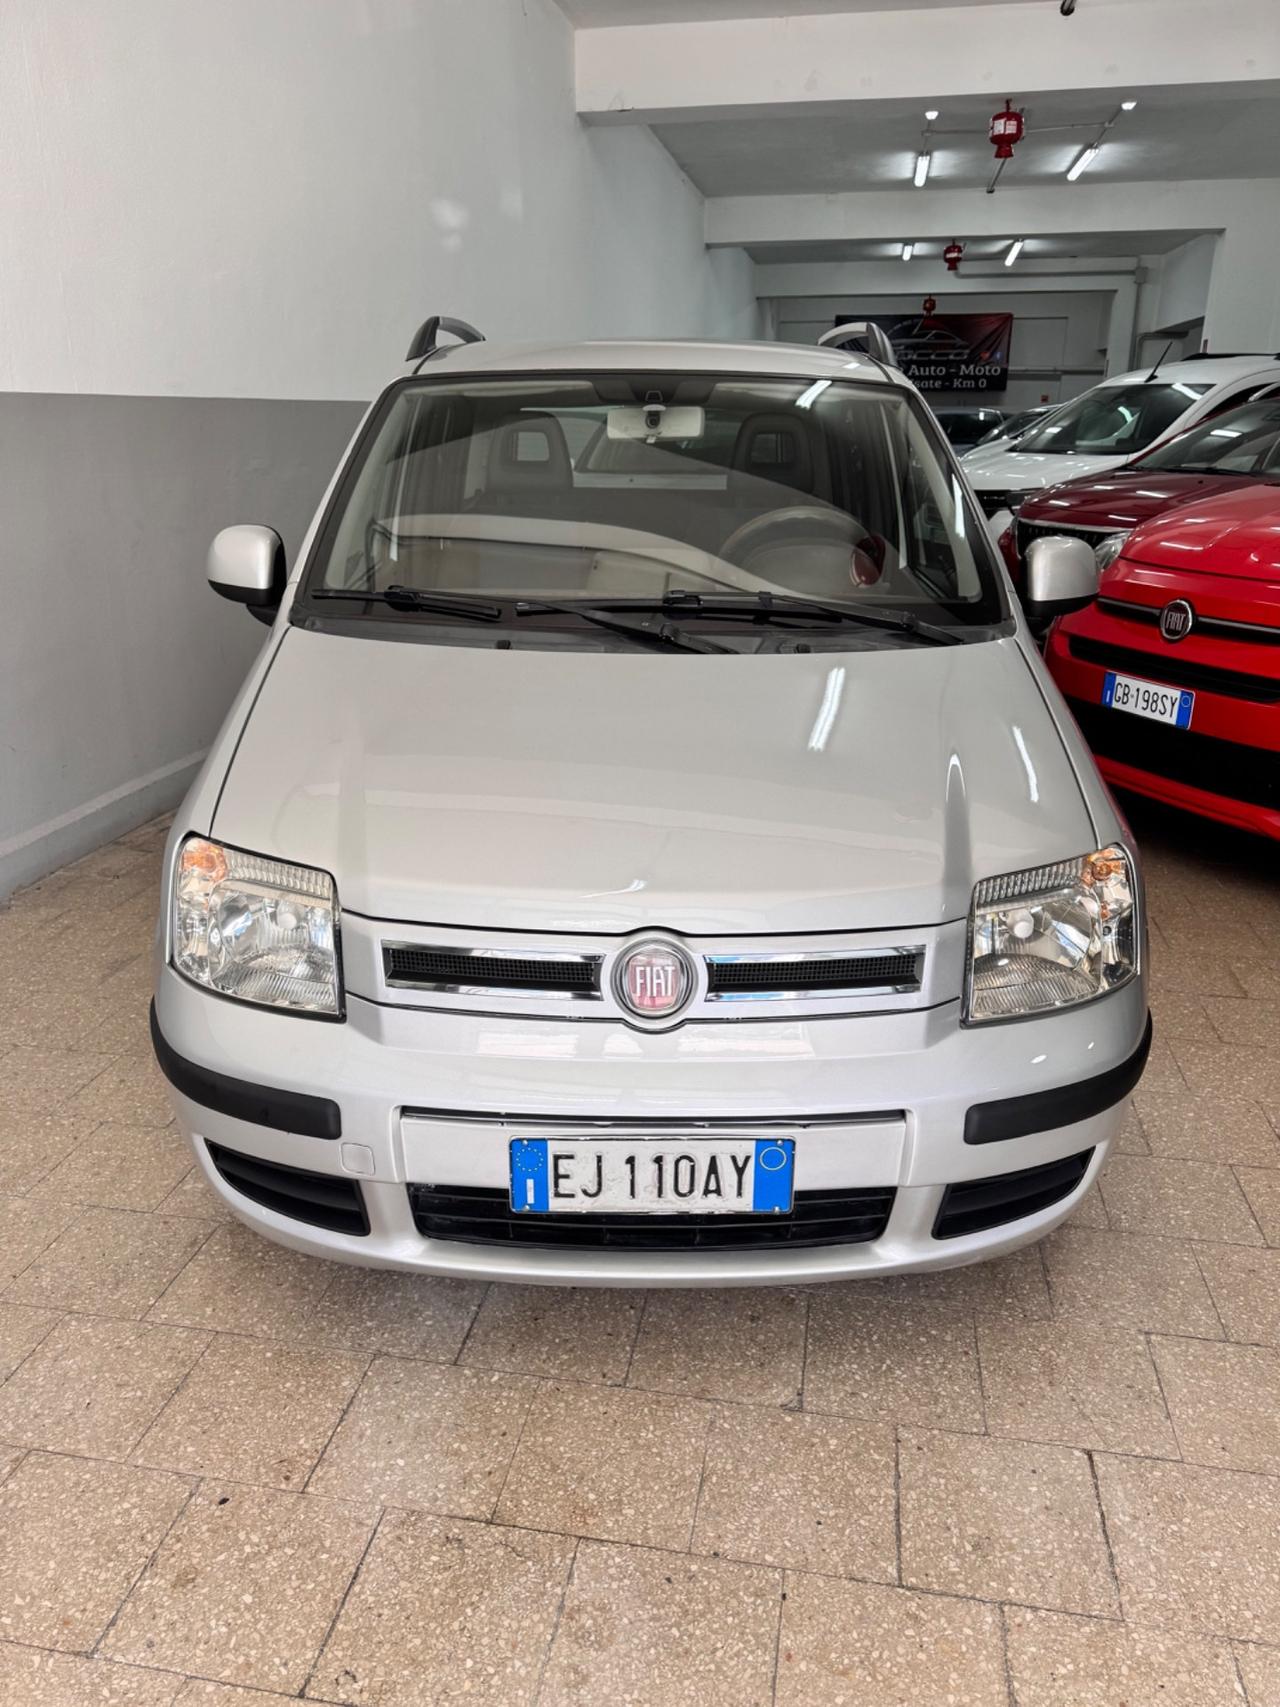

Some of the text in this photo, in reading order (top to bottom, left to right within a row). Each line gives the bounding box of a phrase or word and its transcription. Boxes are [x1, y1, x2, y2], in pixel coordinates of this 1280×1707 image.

[907, 364, 946, 376] Auto
[960, 364, 1001, 376] Moto
[912, 378, 942, 389] sate
[952, 378, 976, 389] Km
[1165, 611, 1186, 631] FIAT
[636, 966, 676, 997] FIAT
